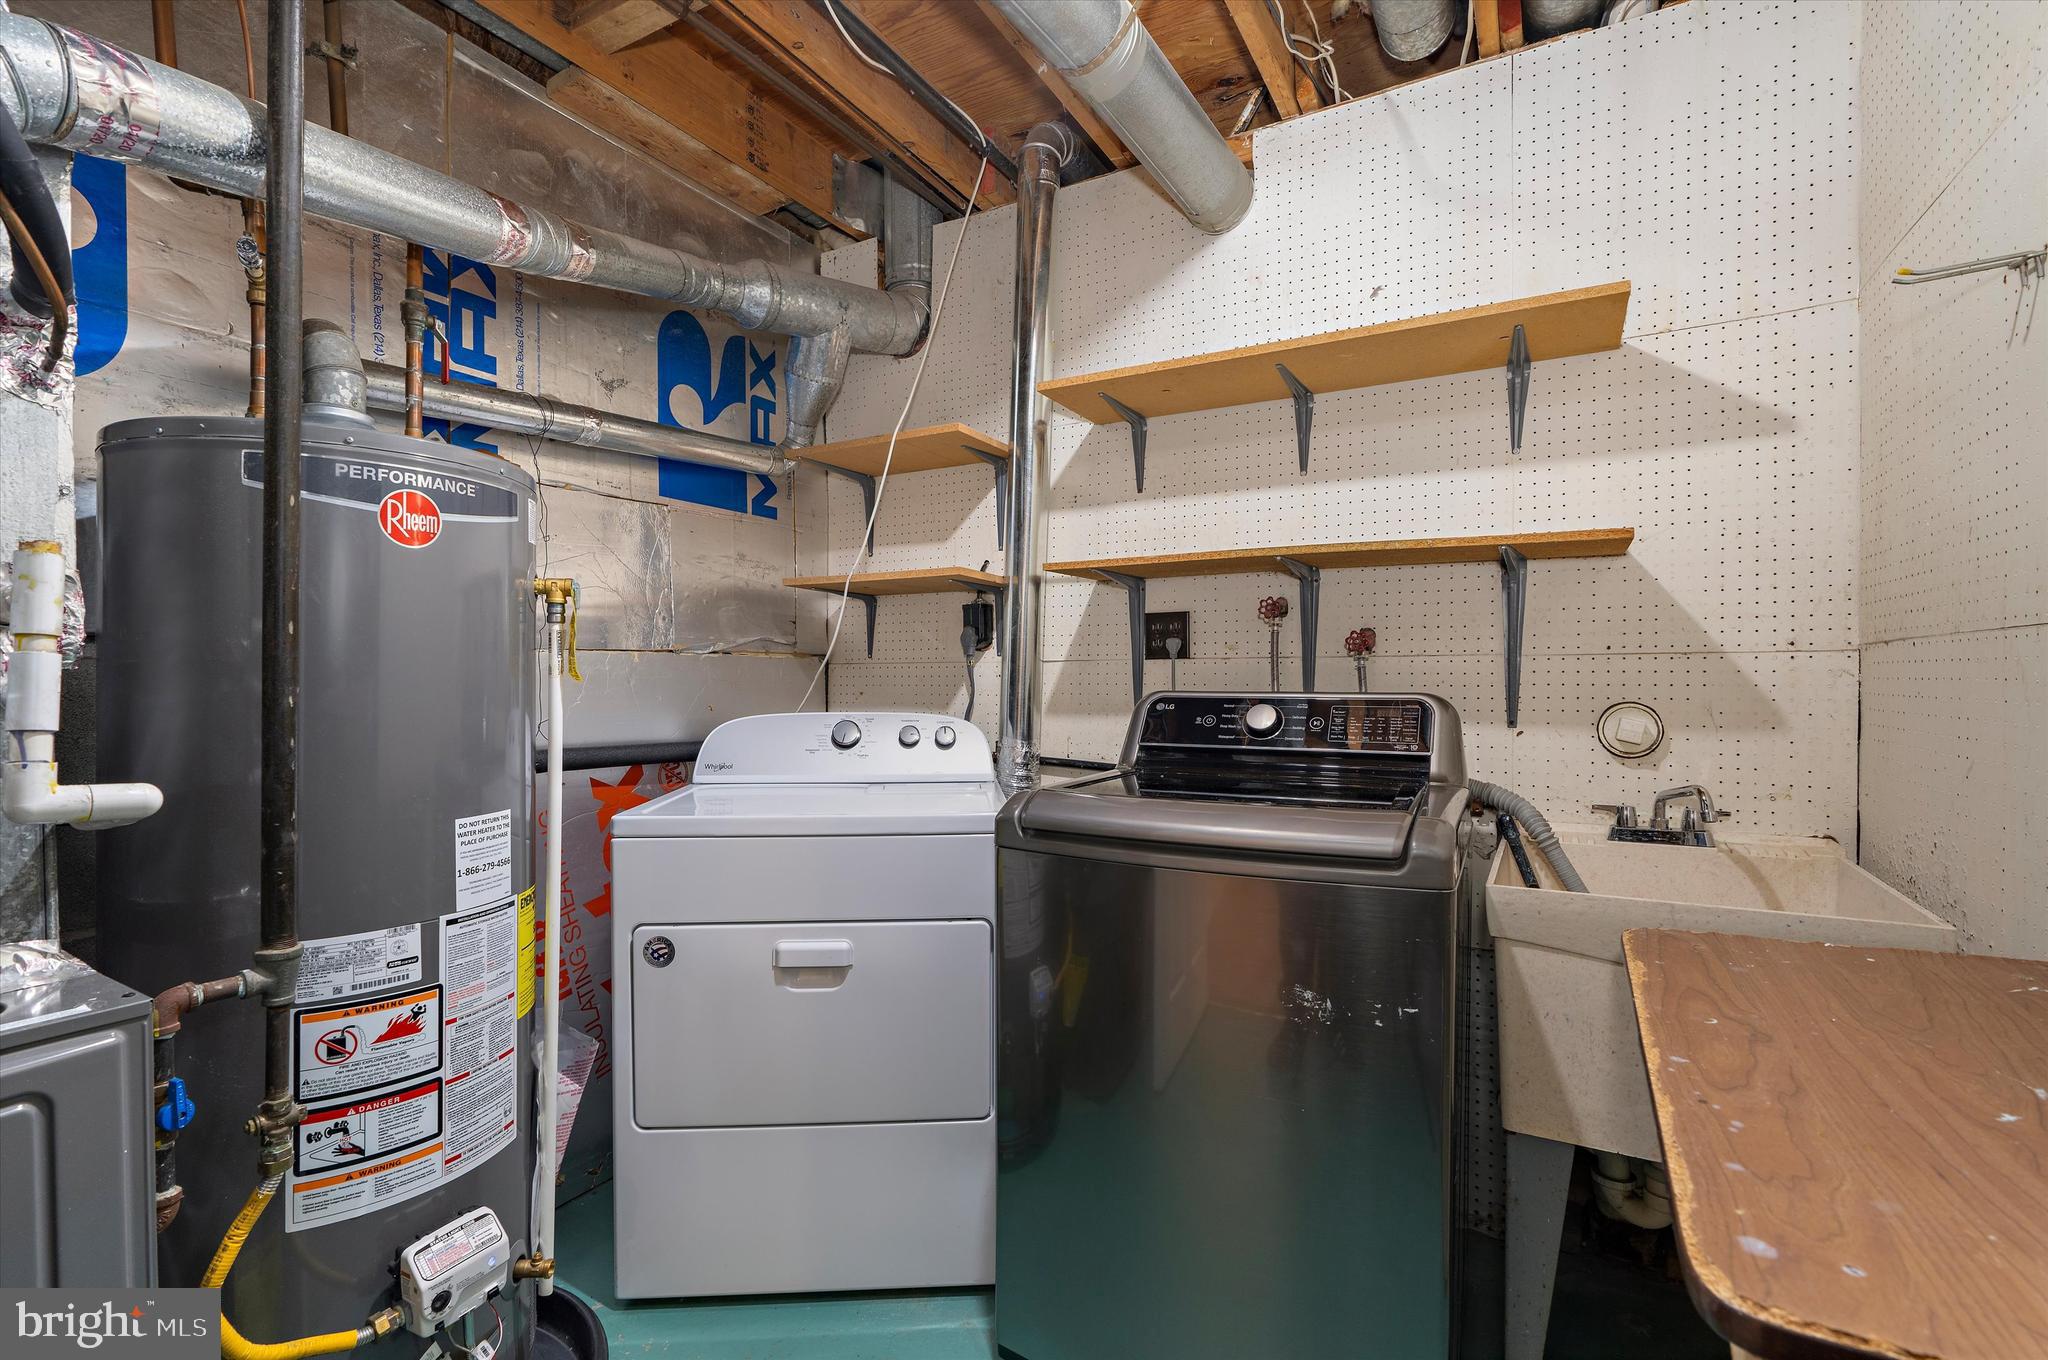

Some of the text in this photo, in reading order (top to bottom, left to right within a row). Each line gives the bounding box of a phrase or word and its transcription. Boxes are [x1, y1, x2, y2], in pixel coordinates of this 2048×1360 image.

[118, 124, 142, 152] 01/20
[372, 272, 383, 302] Dallas,
[374, 304, 384, 330] Texas
[515, 317, 525, 338] (214)
[372, 332, 385, 356] (214)
[515, 340, 524, 362] Texas
[516, 364, 525, 391] Dallas,
[335, 463, 476, 497] PERFORMANCE
[387, 492, 438, 537] Rheem
[704, 763, 733, 772] Whirlpool
[457, 830, 476, 838] WATER
[478, 826, 496, 834] HEATER
[486, 831, 508, 841] PURCHASE
[457, 856, 510, 878] 1-866-279-4566
[355, 1000, 405, 1015] WARNING
[358, 1097, 400, 1113] DANGER
[358, 1160, 401, 1177] WARNING
